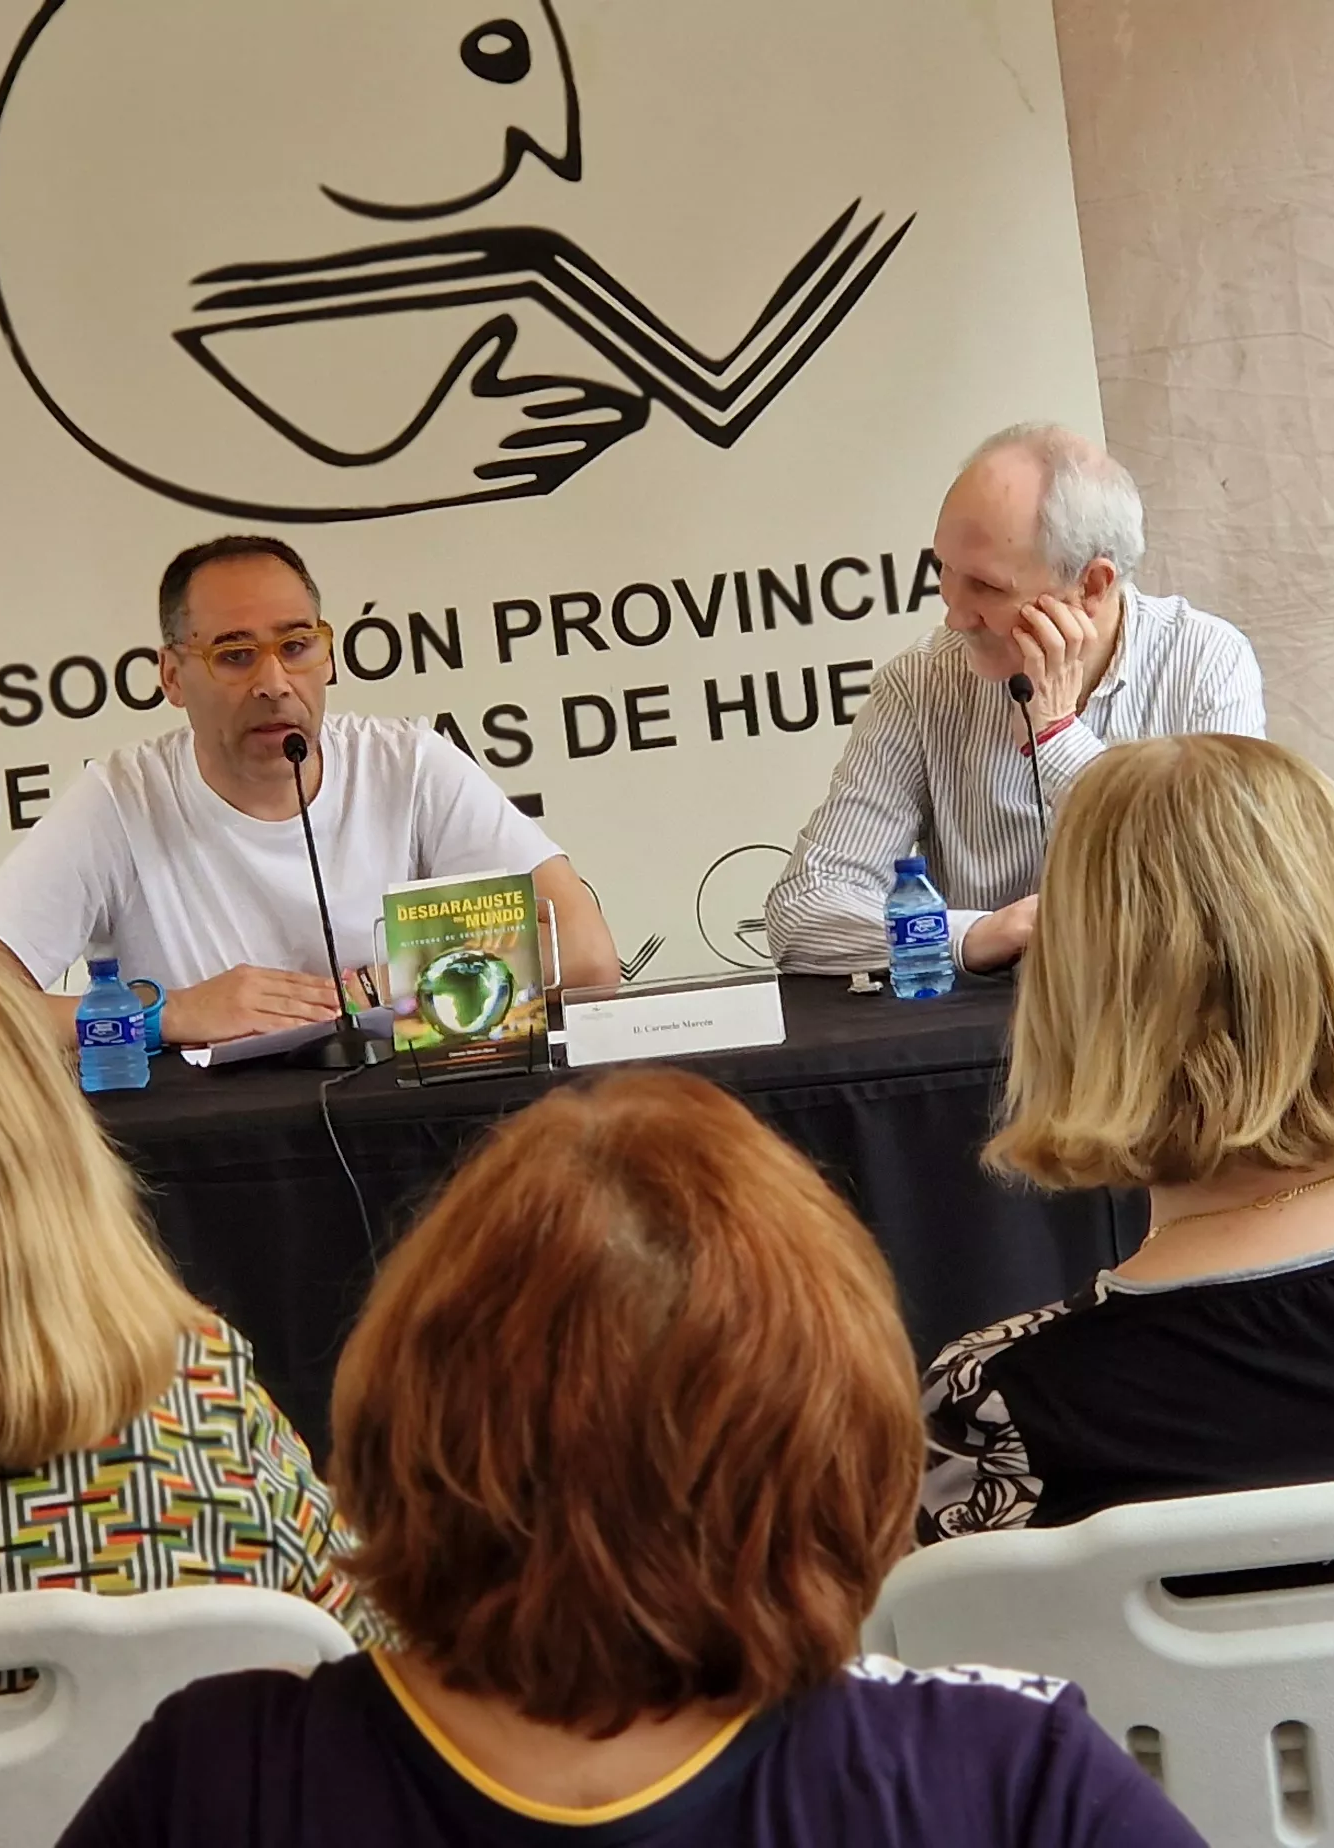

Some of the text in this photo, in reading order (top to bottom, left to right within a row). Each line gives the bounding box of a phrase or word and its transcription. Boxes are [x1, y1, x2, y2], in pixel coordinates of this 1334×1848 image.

[493, 548, 943, 664] PROVINCIA
[561, 684, 678, 760] DE
[704, 658, 875, 742] HUE
[396, 890, 525, 922] DESBARAJUSTE
[466, 907, 525, 929] MUNDO
